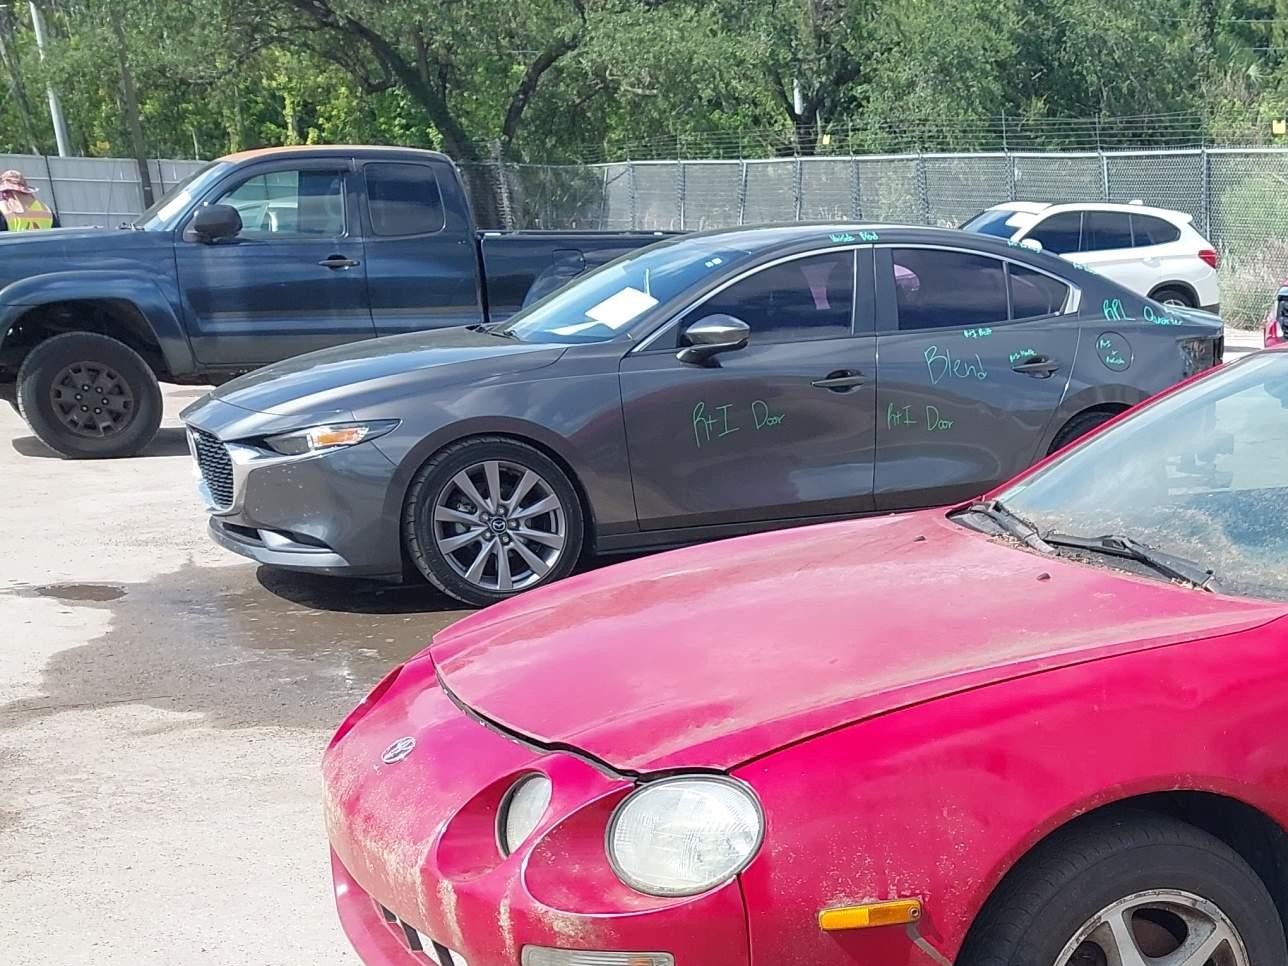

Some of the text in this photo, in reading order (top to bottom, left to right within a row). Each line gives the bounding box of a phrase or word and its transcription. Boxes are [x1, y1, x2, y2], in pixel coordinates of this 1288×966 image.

[924, 345, 988, 385] Blend
[751, 400, 785, 430] Door
[926, 405, 954, 431] Door
